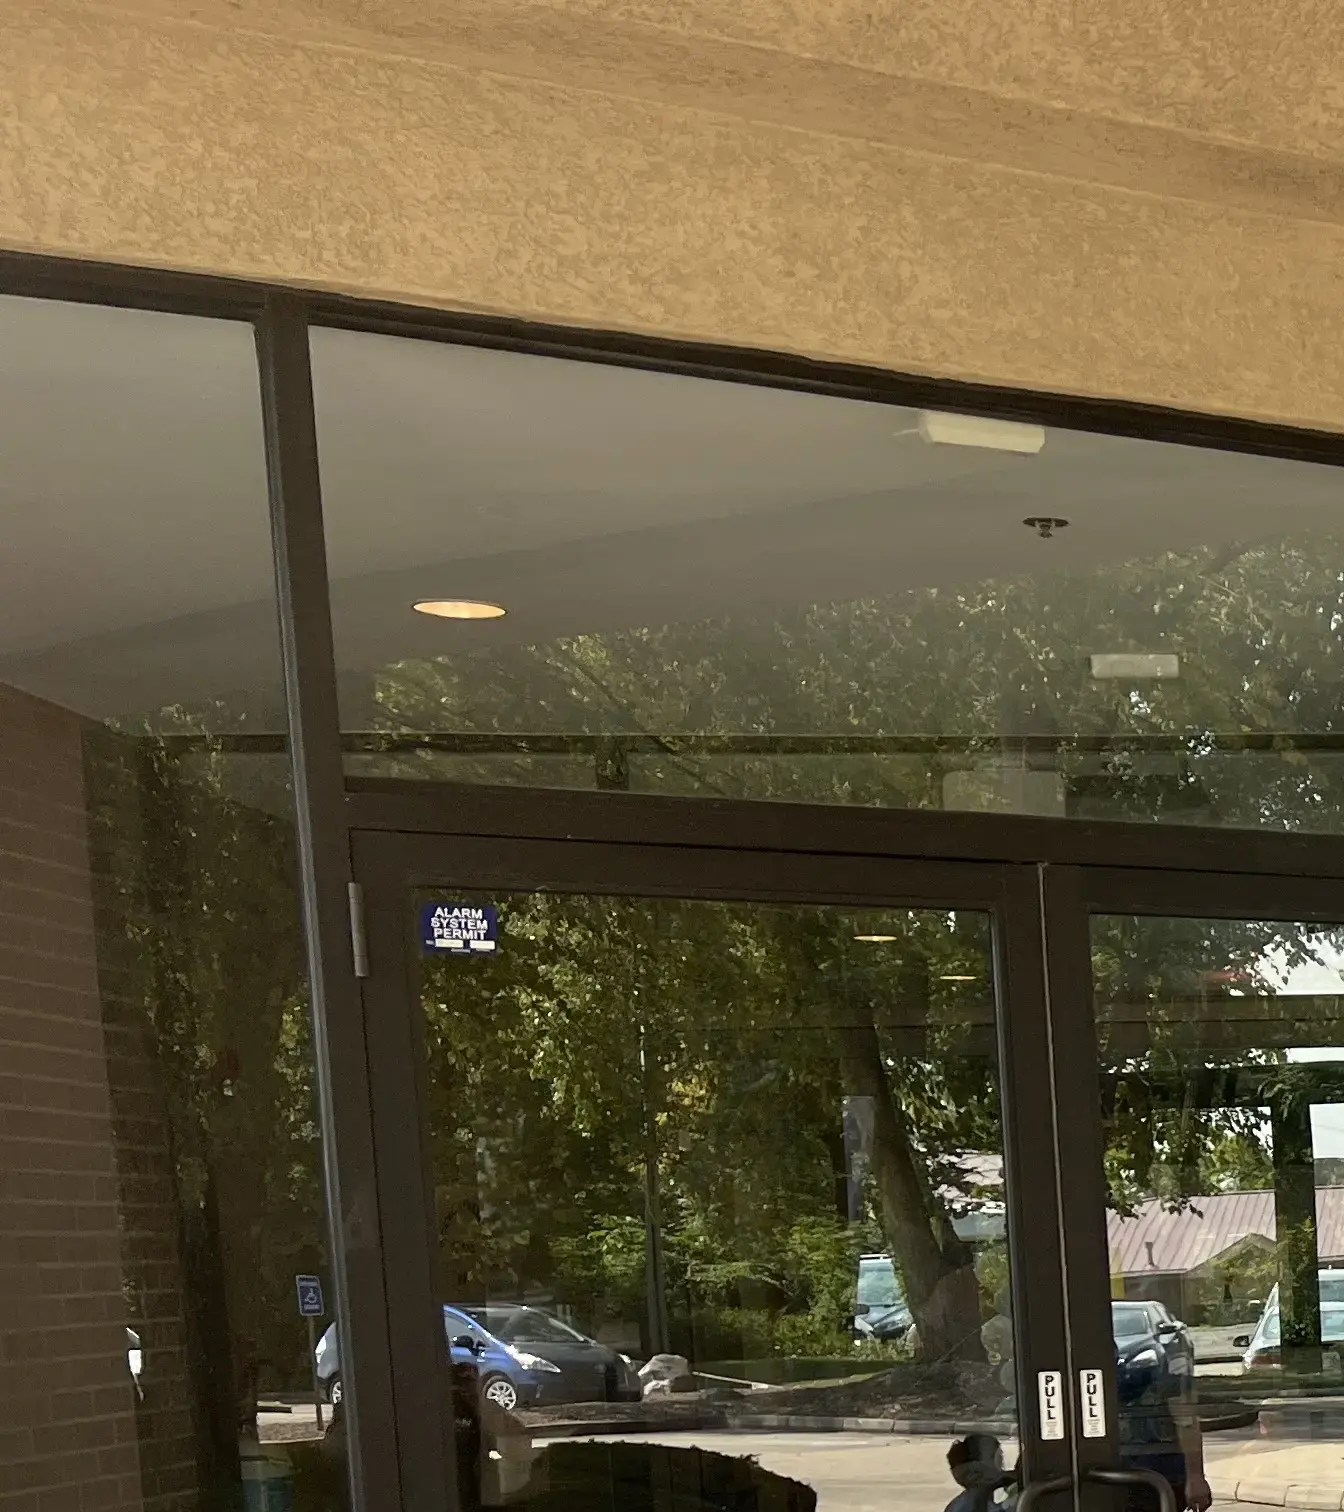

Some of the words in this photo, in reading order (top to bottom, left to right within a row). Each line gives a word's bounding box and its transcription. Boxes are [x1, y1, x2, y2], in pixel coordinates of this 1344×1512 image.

[434, 907, 483, 919] ALARM
[430, 917, 488, 930] SYSTEM
[433, 928, 487, 940] PERMIT
[1044, 1375, 1056, 1420] PULL
[1086, 1373, 1098, 1418] PULL
